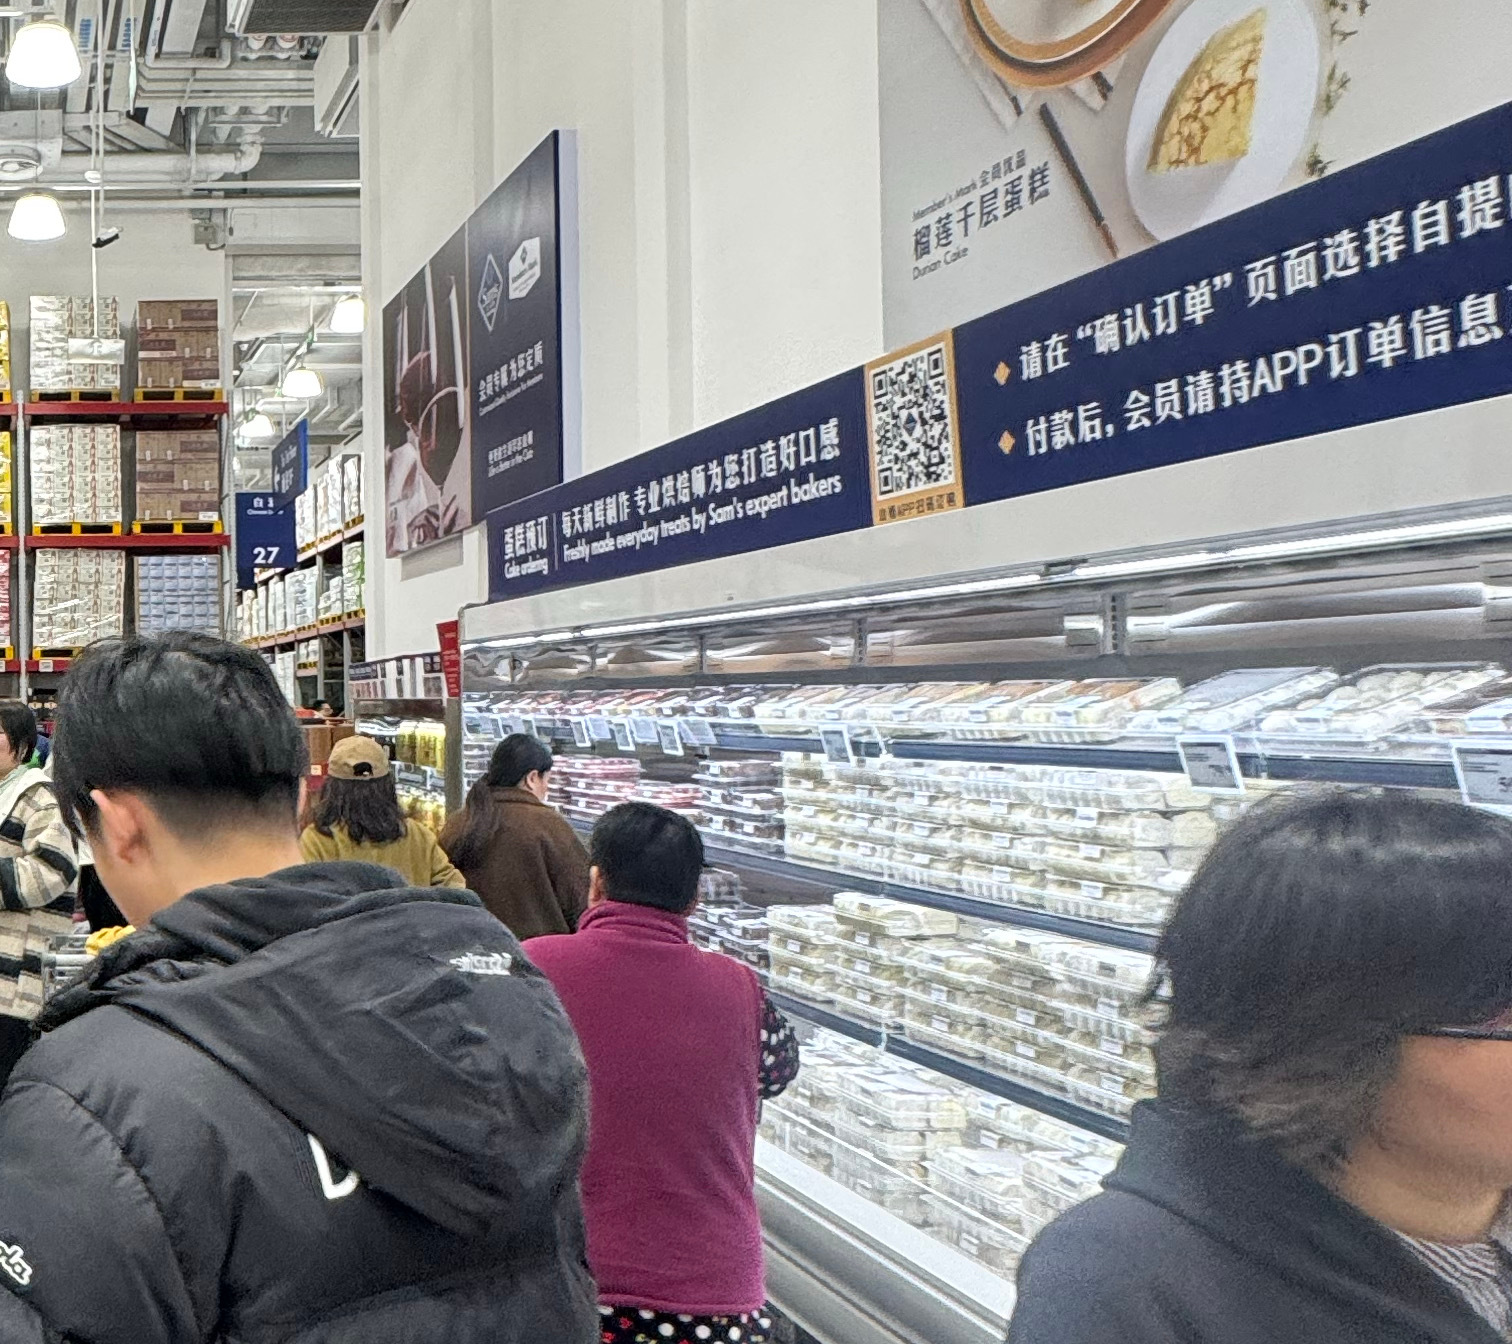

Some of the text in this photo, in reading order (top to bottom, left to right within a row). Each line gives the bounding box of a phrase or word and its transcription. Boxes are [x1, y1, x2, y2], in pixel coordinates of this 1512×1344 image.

[913, 161, 1050, 262] 榴莲千层蛋糕
[253, 546, 280, 564] 27
[591, 531, 615, 555] made
[616, 521, 659, 550] everyday
[660, 515, 691, 538] treats
[691, 507, 706, 534] by
[709, 497, 743, 526] Sam's
[745, 485, 788, 519] expert
[790, 472, 842, 504] bakers
